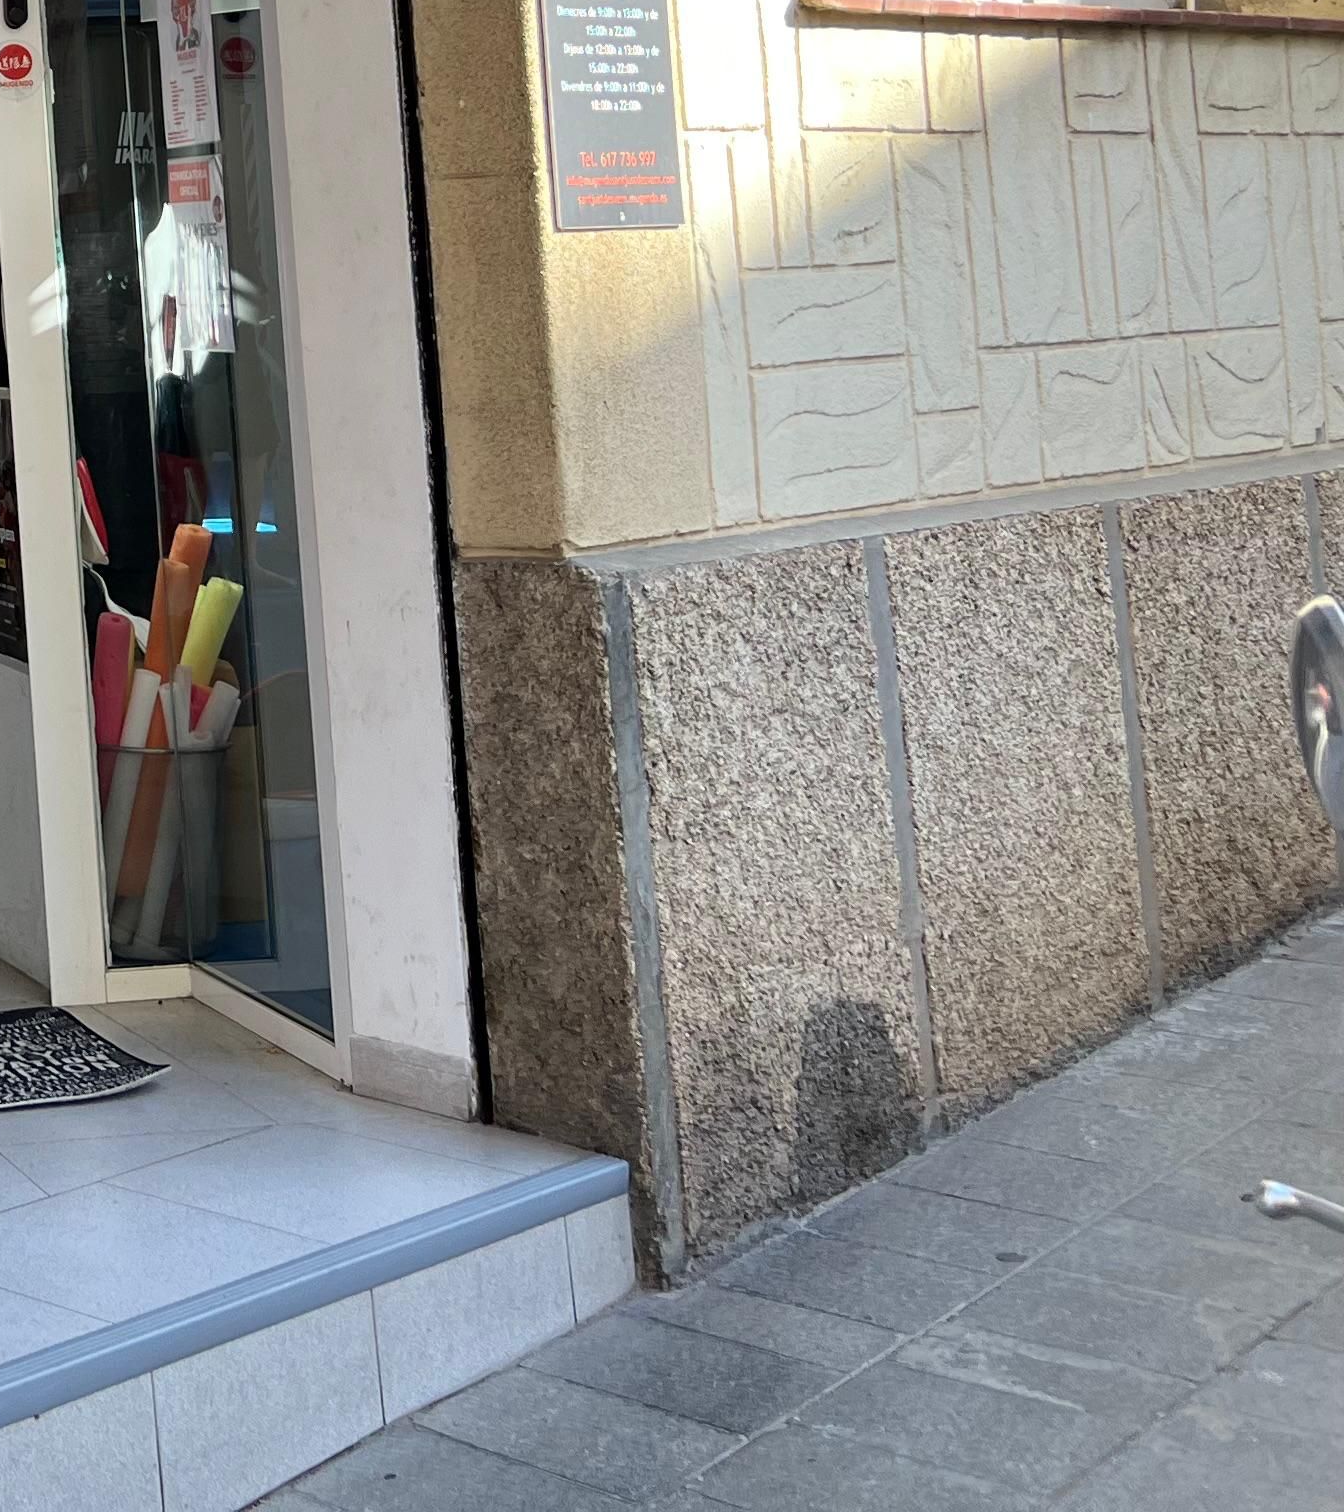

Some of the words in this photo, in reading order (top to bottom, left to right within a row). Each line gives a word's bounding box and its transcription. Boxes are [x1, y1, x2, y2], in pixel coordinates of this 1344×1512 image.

[579, 152, 597, 167] Tel.
[600, 151, 617, 167] 617
[620, 151, 637, 167] 736
[639, 151, 656, 166] 997
